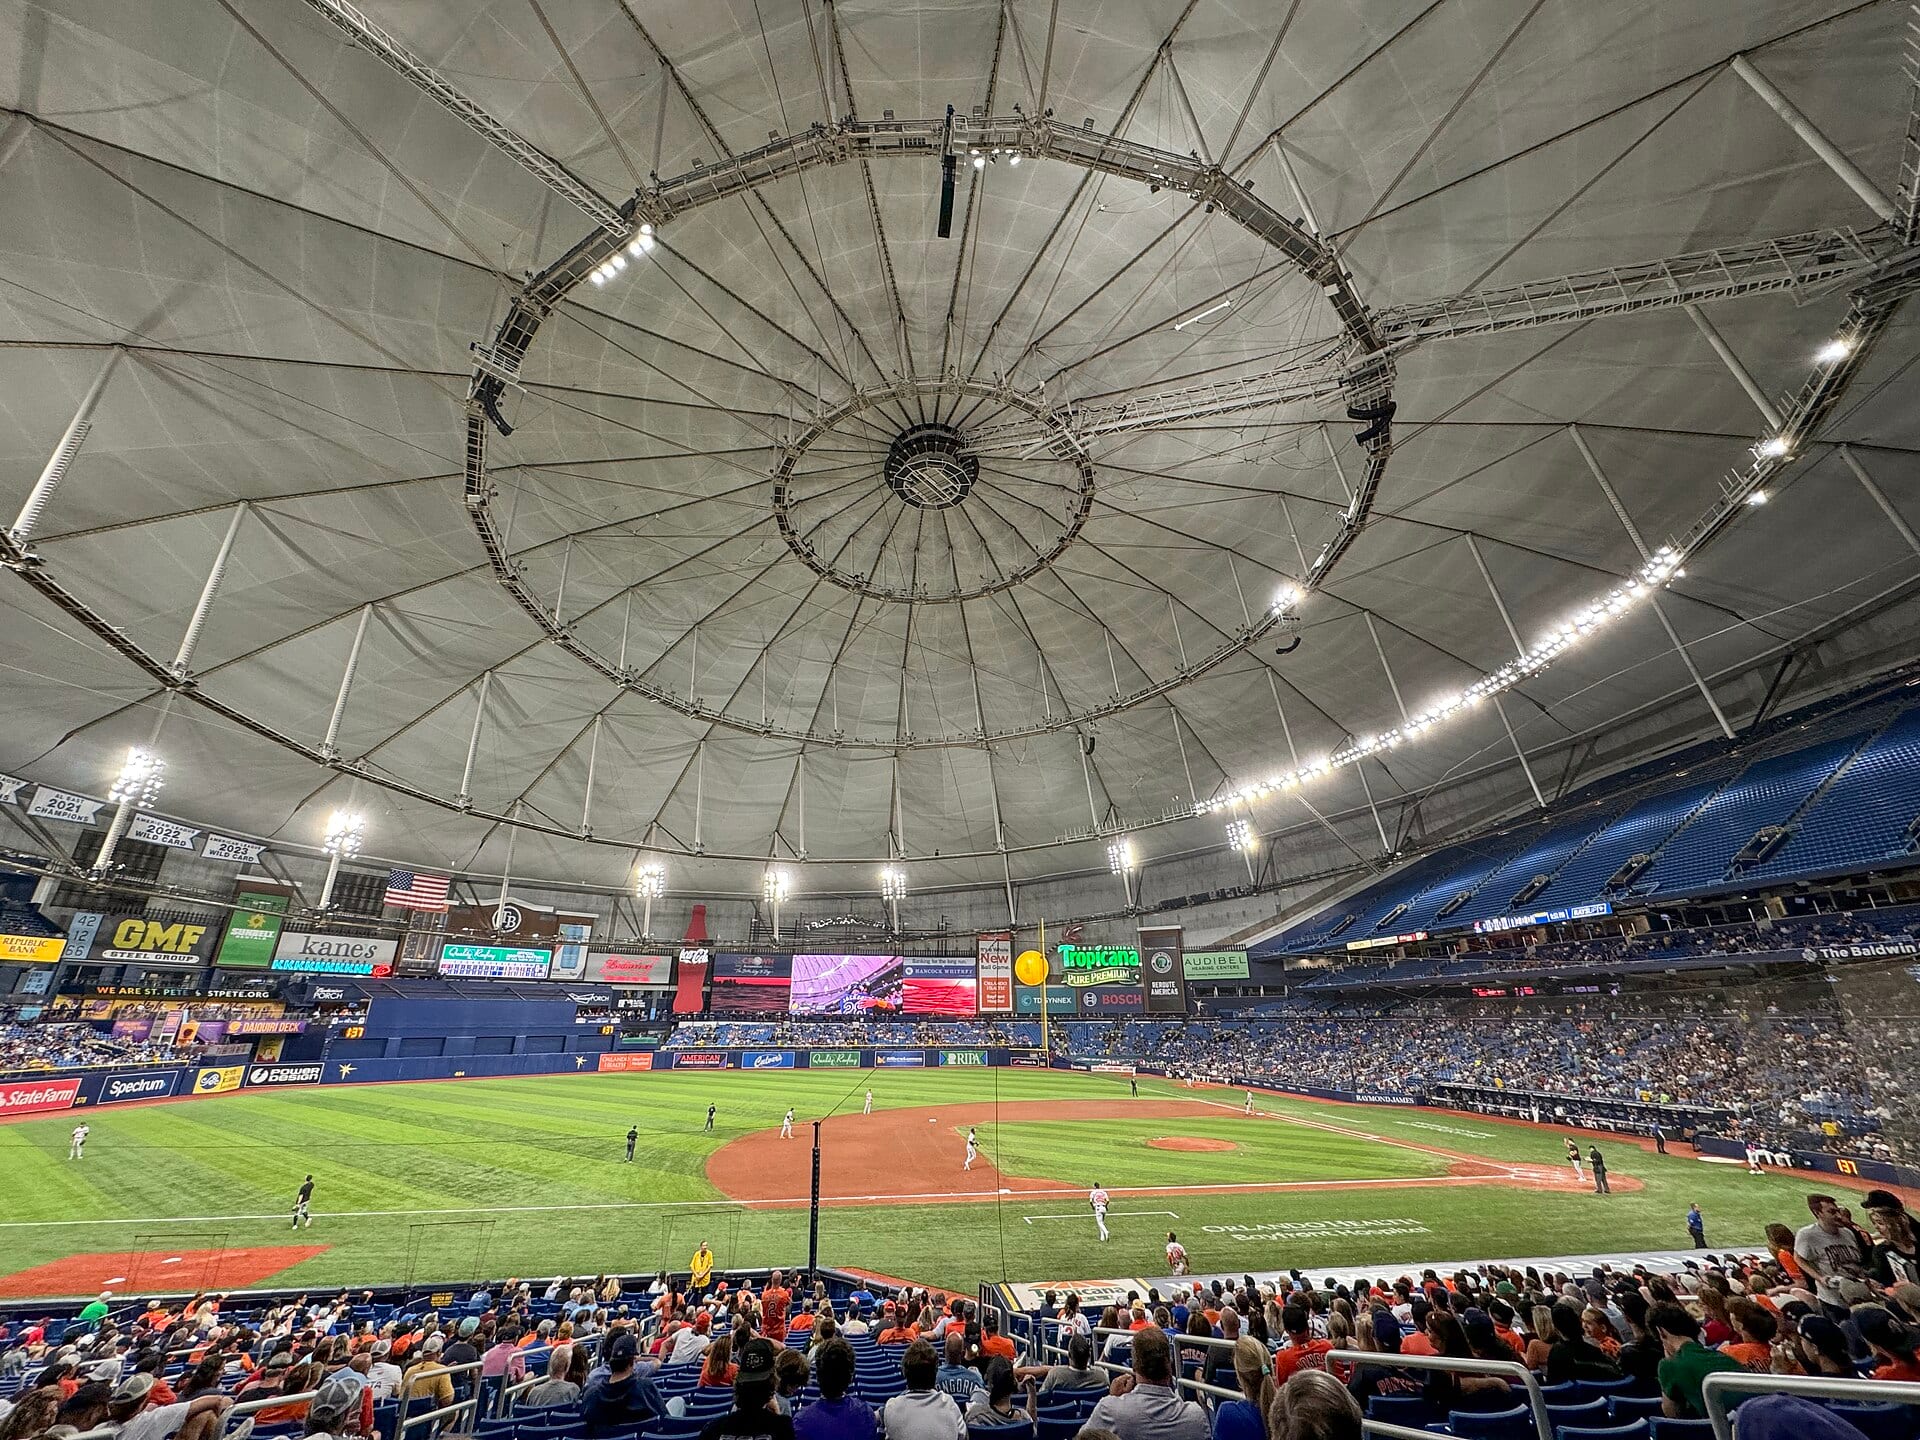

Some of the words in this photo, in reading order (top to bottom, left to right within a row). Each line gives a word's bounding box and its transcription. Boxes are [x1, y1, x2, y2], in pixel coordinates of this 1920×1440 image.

[47, 798, 81, 813] 2021
[34, 806, 89, 822] CHAMPIONS
[136, 816, 169, 828] AMERICAN
[146, 824, 181, 839] 2022
[135, 830, 158, 841] WILD
[161, 836, 187, 847] CARD
[209, 836, 238, 846] AMERICAN
[209, 848, 230, 858] WILD
[232, 853, 254, 862] CARD
[219, 843, 249, 855] 2023
[78, 915, 97, 927] 42
[73, 930, 89, 941] 12
[112, 918, 207, 953] GMF
[2, 937, 49, 948] REPUBLIC
[8, 945, 37, 954] BANK
[65, 944, 85, 956] 66
[1820, 947, 1849, 959] The
[1850, 942, 1917, 957] Baldwin
[110, 951, 150, 960] STEEL
[154, 952, 194, 962] GROUP
[981, 953, 1009, 963] New
[1058, 944, 1139, 970] Tropicana
[1184, 956, 1247, 966] AUDIBEL
[1067, 974, 1090, 984] PURE
[1091, 969, 1130, 983] PREMIUM
[97, 986, 116, 995] WE
[118, 986, 141, 995] ARE
[144, 987, 160, 996] ST.
[163, 988, 189, 997] PETE
[207, 990, 270, 998] STPETE.ORG
[1102, 994, 1142, 1005] BOSCH
[242, 1022, 277, 1033] DAIQUIRI
[279, 1022, 301, 1032] DECK
[957, 1053, 982, 1065] RIPA
[109, 1079, 164, 1096] Spectrum
[1356, 1094, 1391, 1103] RAYMOND
[1391, 1096, 1415, 1104] JAMES
[1201, 1221, 1326, 1233] ORLANDO
[1324, 1218, 1424, 1227] HEALTH
[1028, 1285, 1126, 1298] Topicana
[768, 1302, 777, 1317] 2
